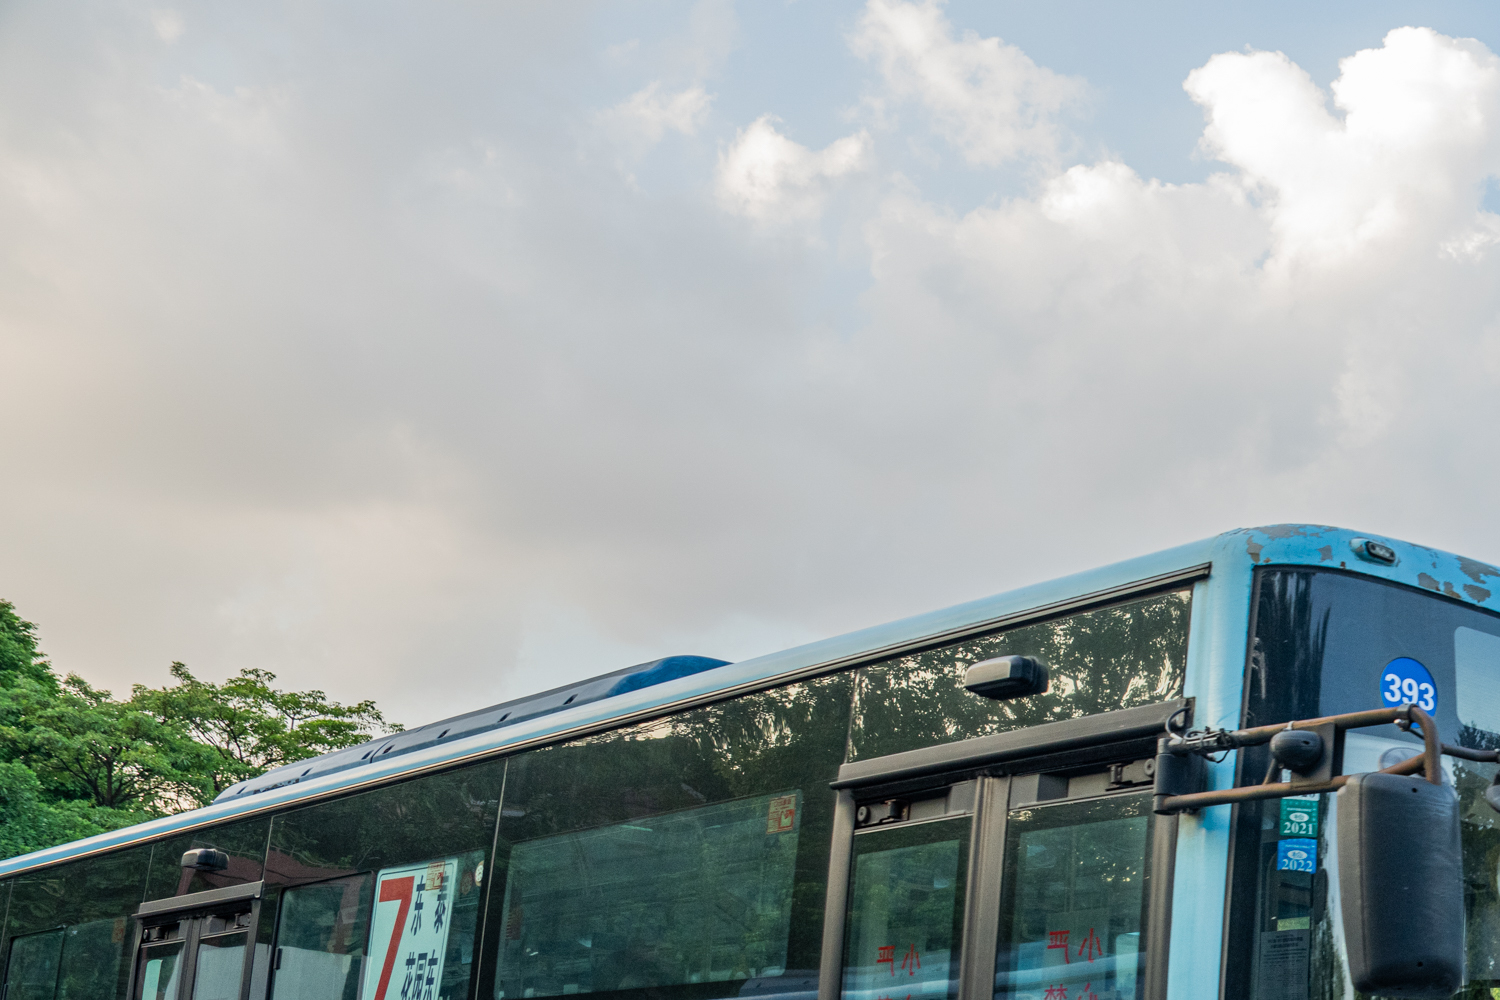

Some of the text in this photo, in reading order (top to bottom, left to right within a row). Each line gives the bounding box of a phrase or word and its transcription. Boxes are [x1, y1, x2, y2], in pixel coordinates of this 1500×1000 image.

[1384, 673, 1435, 711] 393
[1283, 821, 1314, 835] 2021
[1281, 858, 1313, 872] 2022
